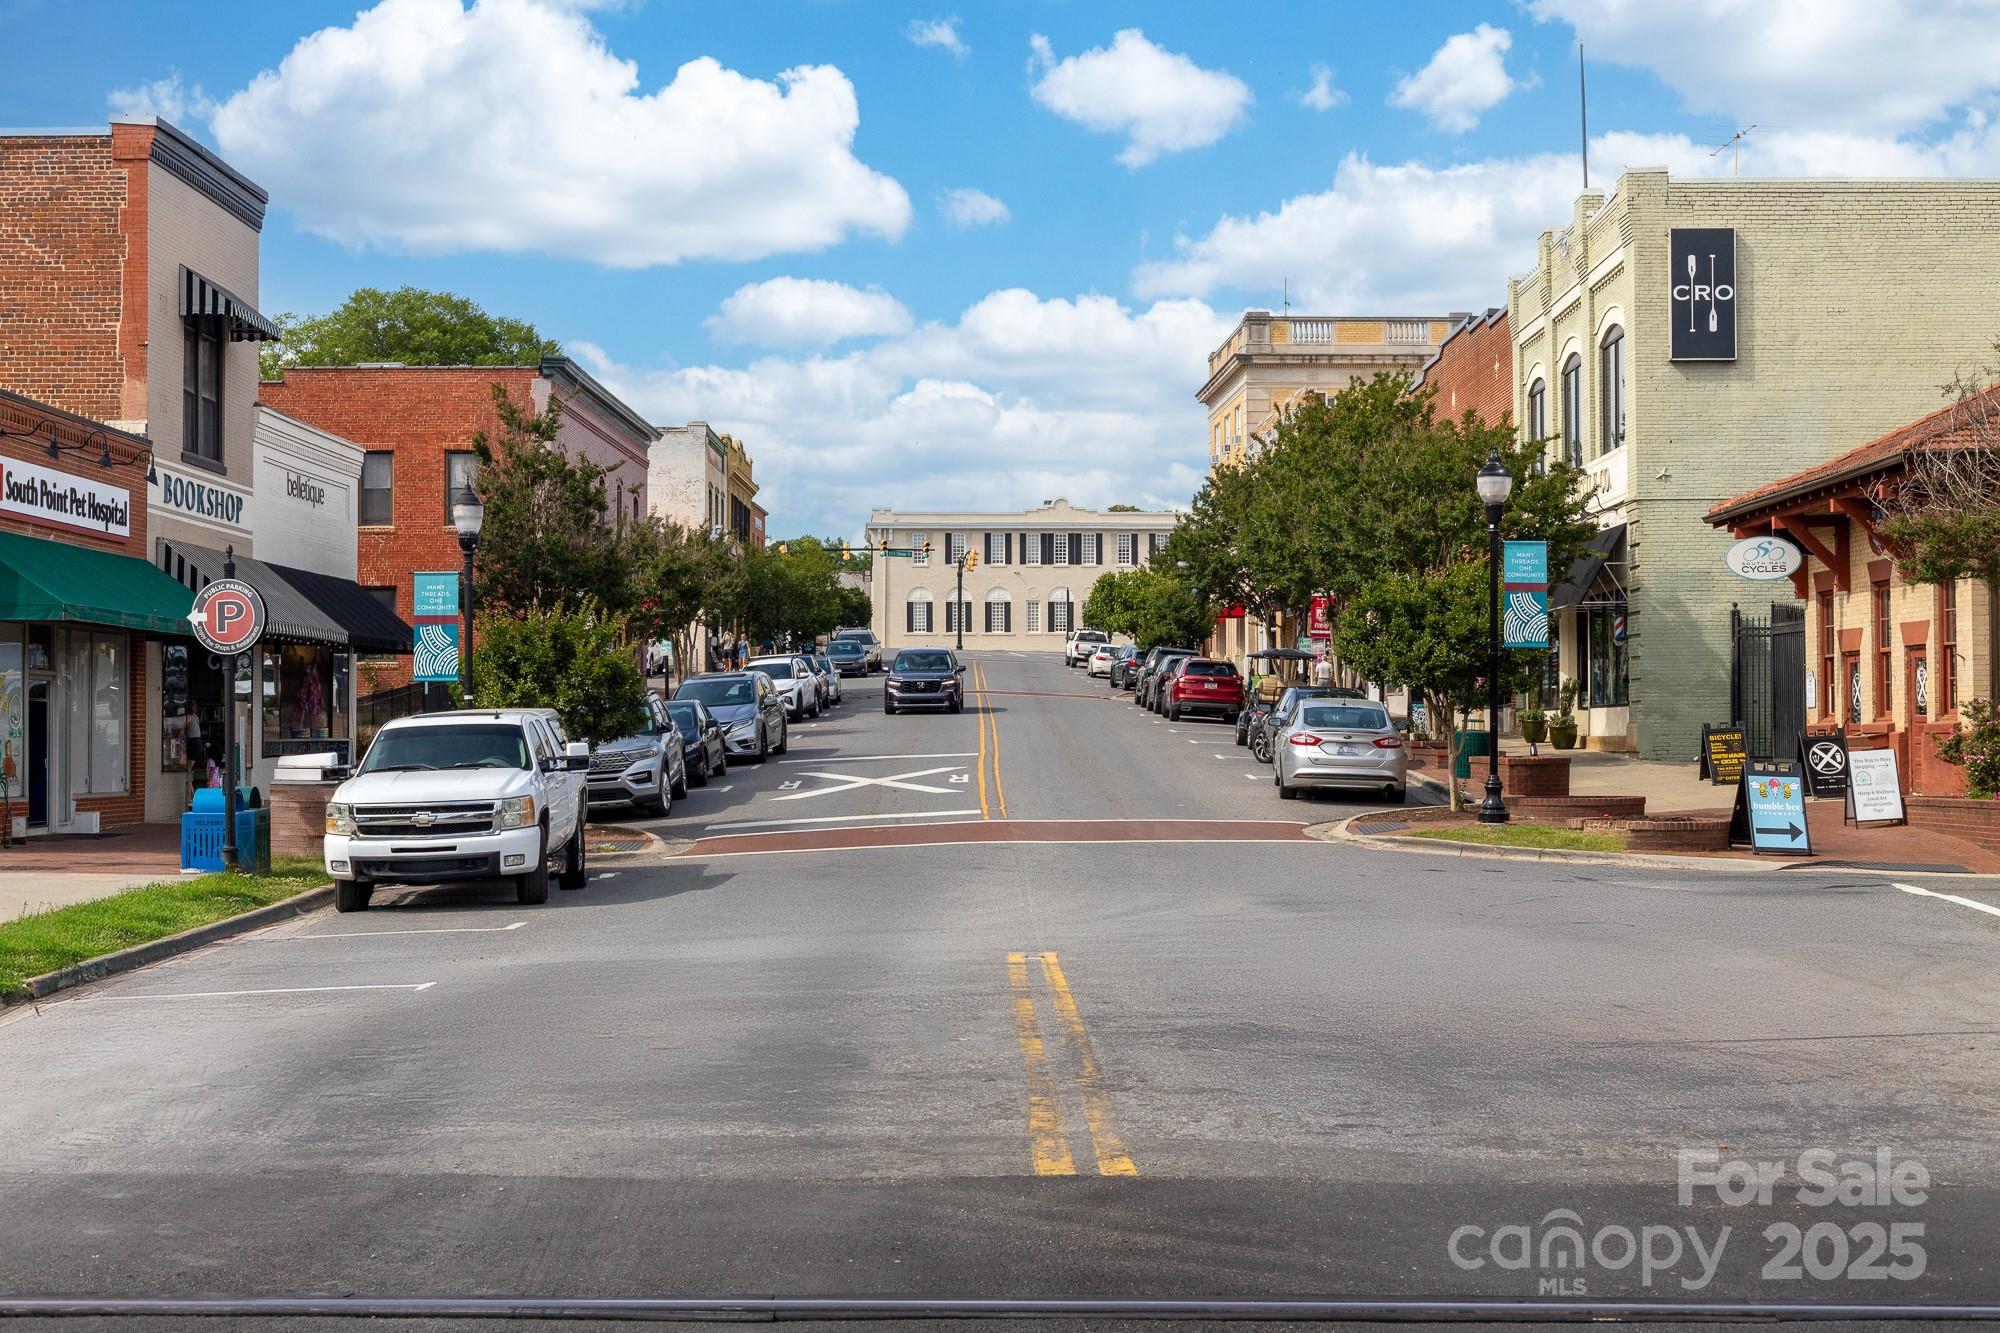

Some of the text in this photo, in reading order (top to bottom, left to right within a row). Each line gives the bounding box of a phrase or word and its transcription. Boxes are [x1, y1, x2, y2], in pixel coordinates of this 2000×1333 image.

[6, 471, 127, 531] South Point Pet Hospital
[163, 473, 243, 524] BOOKSHOP
[287, 472, 325, 508] belletique
[1741, 565, 1787, 573] CYCLES
[203, 584, 254, 599] PUBLIC PARKING
[216, 599, 246, 634] P
[214, 642, 231, 652] Shops
[236, 625, 260, 649] Restaurants
[1753, 801, 1801, 811] bumble bee
